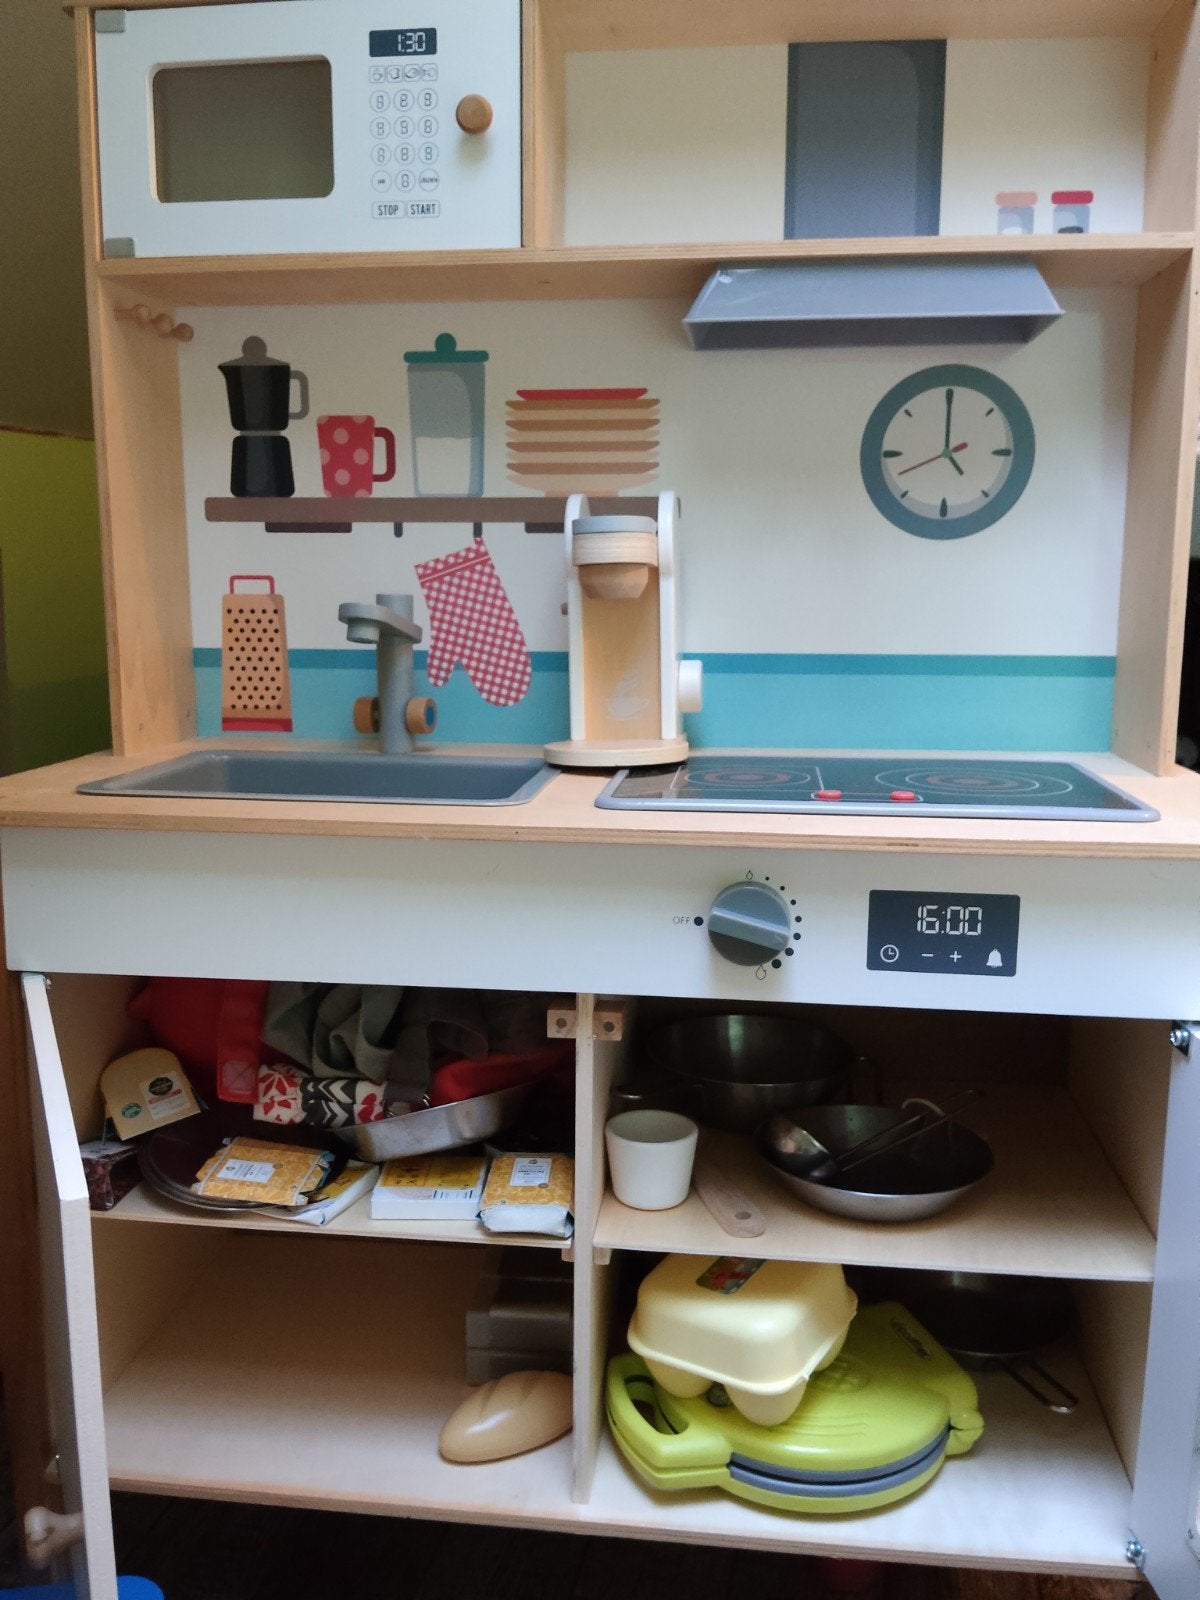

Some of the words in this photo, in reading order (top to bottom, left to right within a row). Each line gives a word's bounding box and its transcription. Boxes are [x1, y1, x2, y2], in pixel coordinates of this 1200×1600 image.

[397, 32, 426, 53] 1:30
[377, 204, 399, 216] STOP
[410, 203, 436, 215] START
[672, 916, 691, 925] OFF
[916, 905, 983, 936] 16:00
